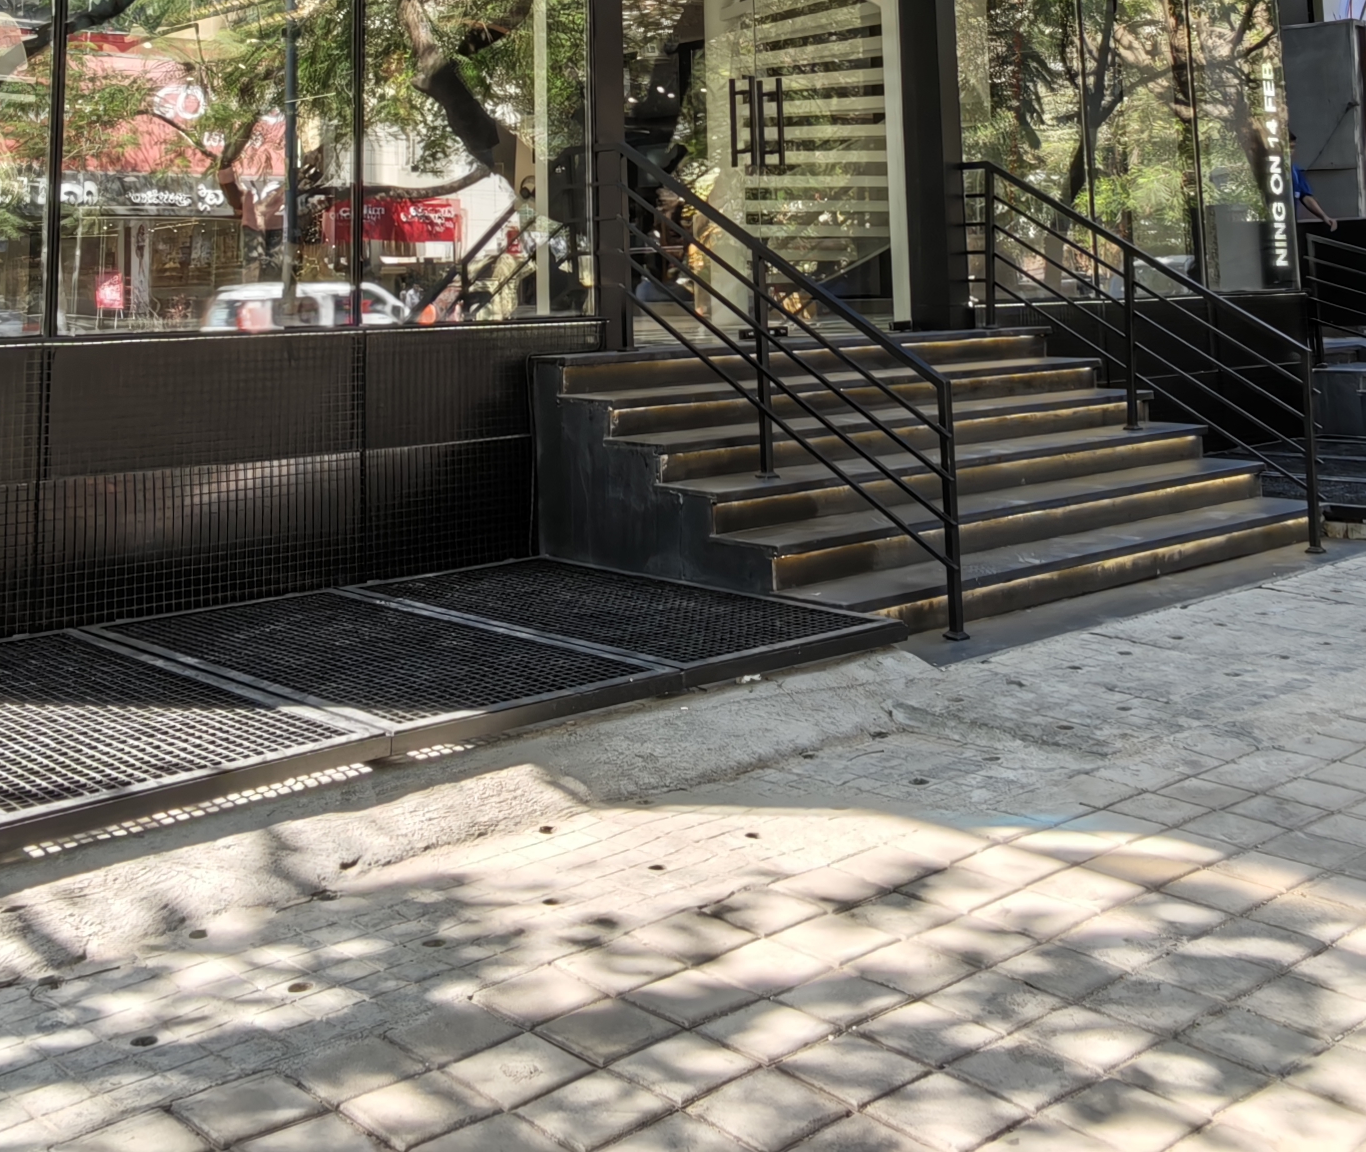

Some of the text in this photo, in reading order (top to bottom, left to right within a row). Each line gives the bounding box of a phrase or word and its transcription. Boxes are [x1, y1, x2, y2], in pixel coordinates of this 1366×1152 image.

[1261, 61, 1289, 267] NING ON 14 FEB
